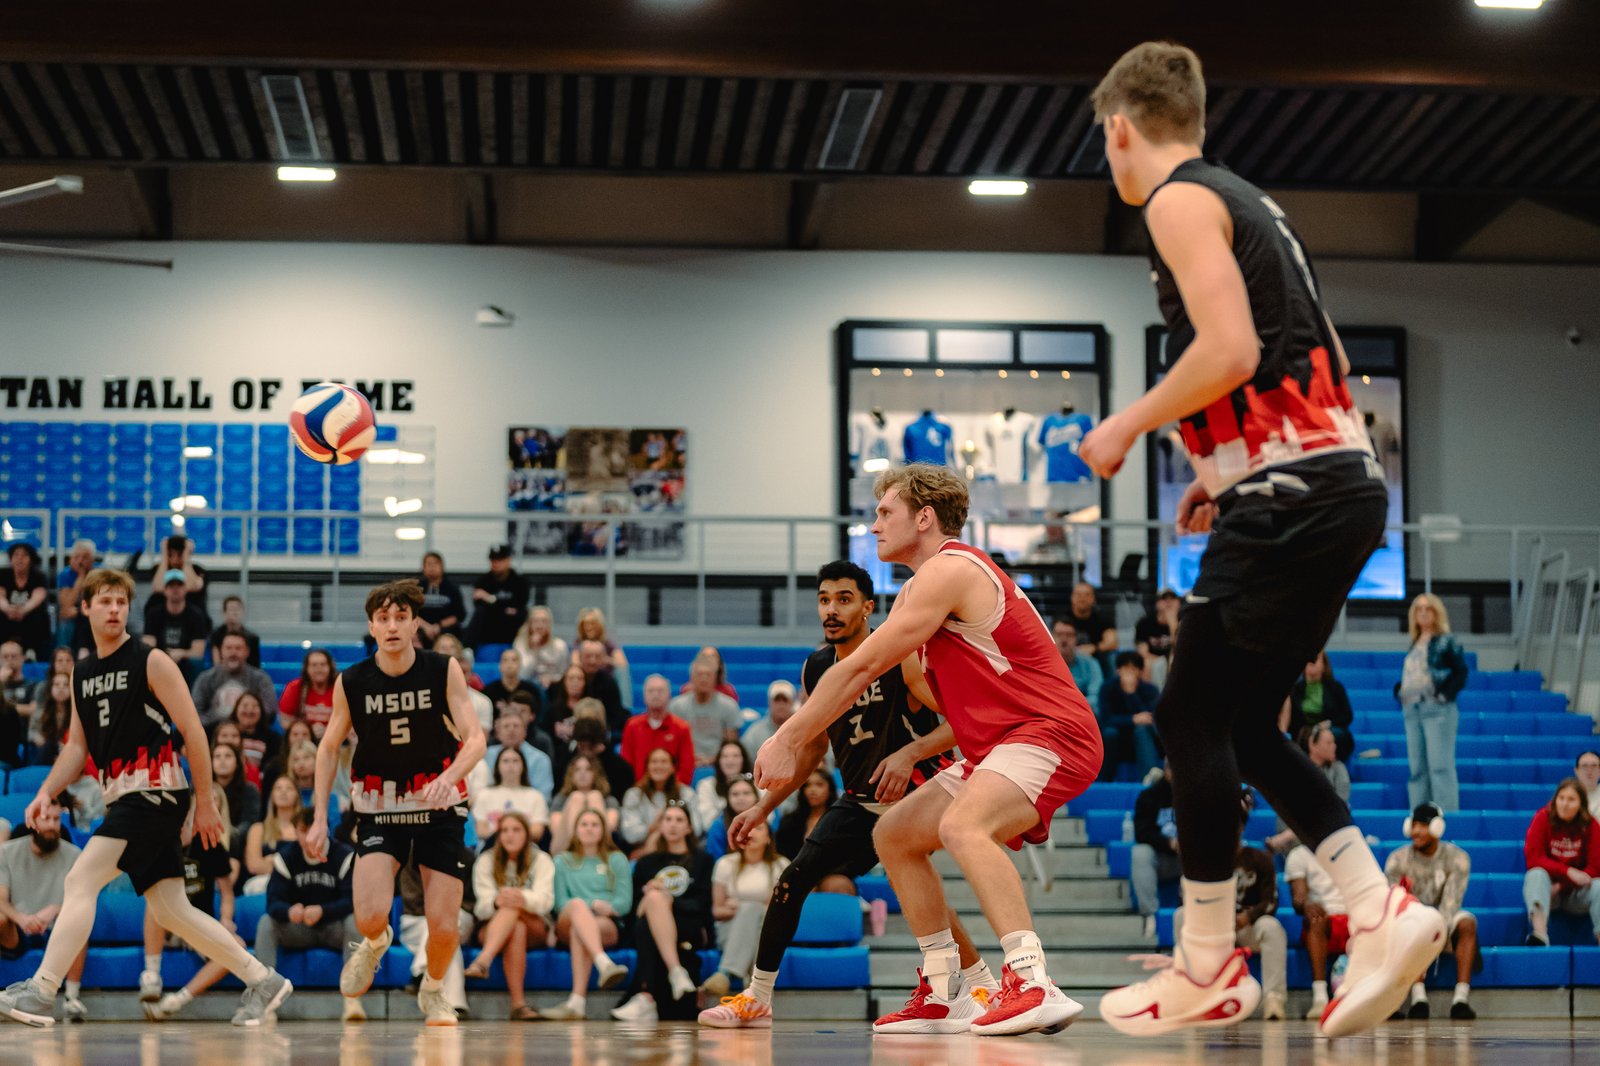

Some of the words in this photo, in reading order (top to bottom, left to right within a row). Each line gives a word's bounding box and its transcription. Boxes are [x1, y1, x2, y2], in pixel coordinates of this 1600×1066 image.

[103, 379, 211, 409] HALL
[233, 380, 281, 410] OF
[301, 380, 413, 411] ME
[82, 670, 129, 698] MSOE
[97, 698, 110, 727] 2
[365, 689, 432, 715] MSOE
[390, 717, 411, 745] 5
[848, 714, 875, 745] 1
